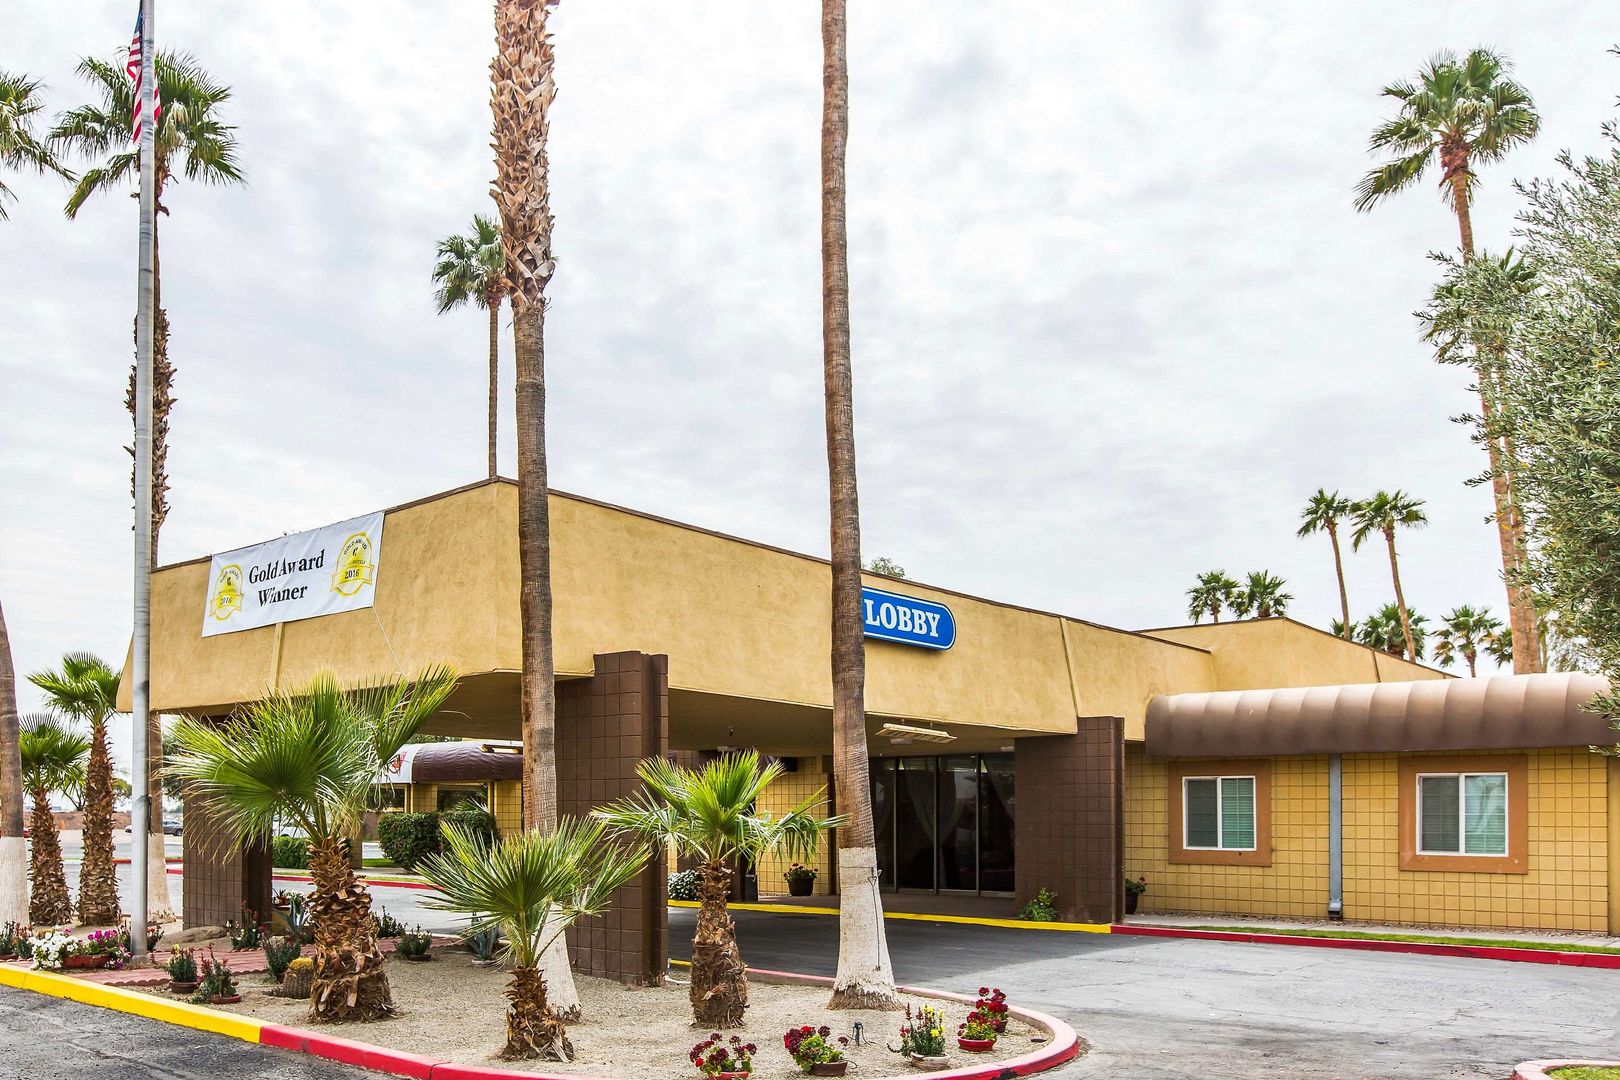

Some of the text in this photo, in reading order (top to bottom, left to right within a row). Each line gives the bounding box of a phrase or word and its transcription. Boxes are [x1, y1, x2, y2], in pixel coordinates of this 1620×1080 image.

[249, 549, 325, 584] Gold Award
[344, 569, 360, 579] 2016
[258, 584, 308, 607] Winner
[863, 598, 941, 638] LOBBY
